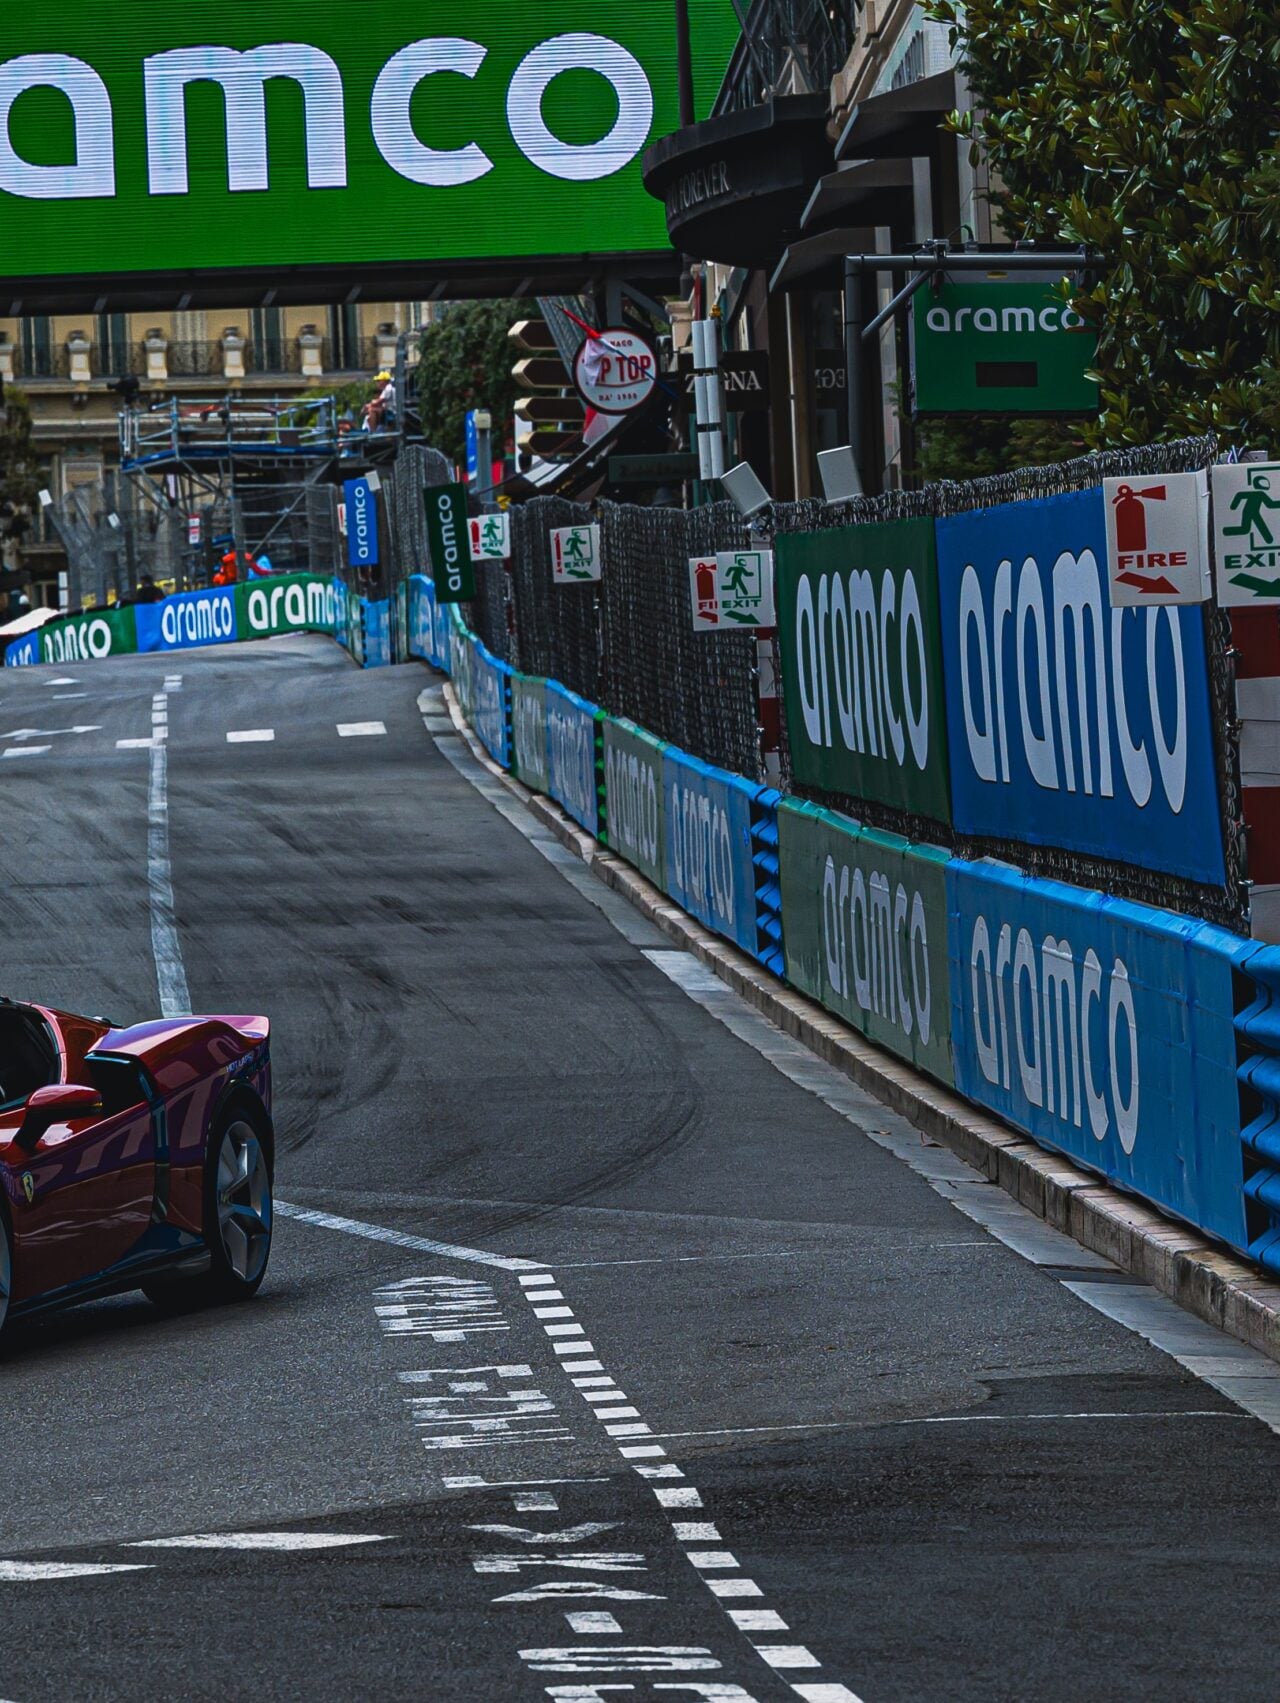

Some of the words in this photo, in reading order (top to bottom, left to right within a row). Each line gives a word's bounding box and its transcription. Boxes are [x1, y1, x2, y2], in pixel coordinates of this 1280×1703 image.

[926, 307, 1085, 332] aramco
[685, 370, 763, 393] ZNA
[354, 486, 369, 559] aramco
[437, 494, 461, 592] aramco
[564, 560, 592, 569] EXIT
[1118, 552, 1188, 570] FIRE
[1224, 553, 1280, 570] EXI
[162, 597, 233, 644] aramco
[722, 599, 762, 609] EXIT
[796, 567, 930, 771] aramco
[959, 548, 1186, 814] aramco
[824, 854, 931, 1047] aramco
[971, 915, 1139, 1155] aramco
